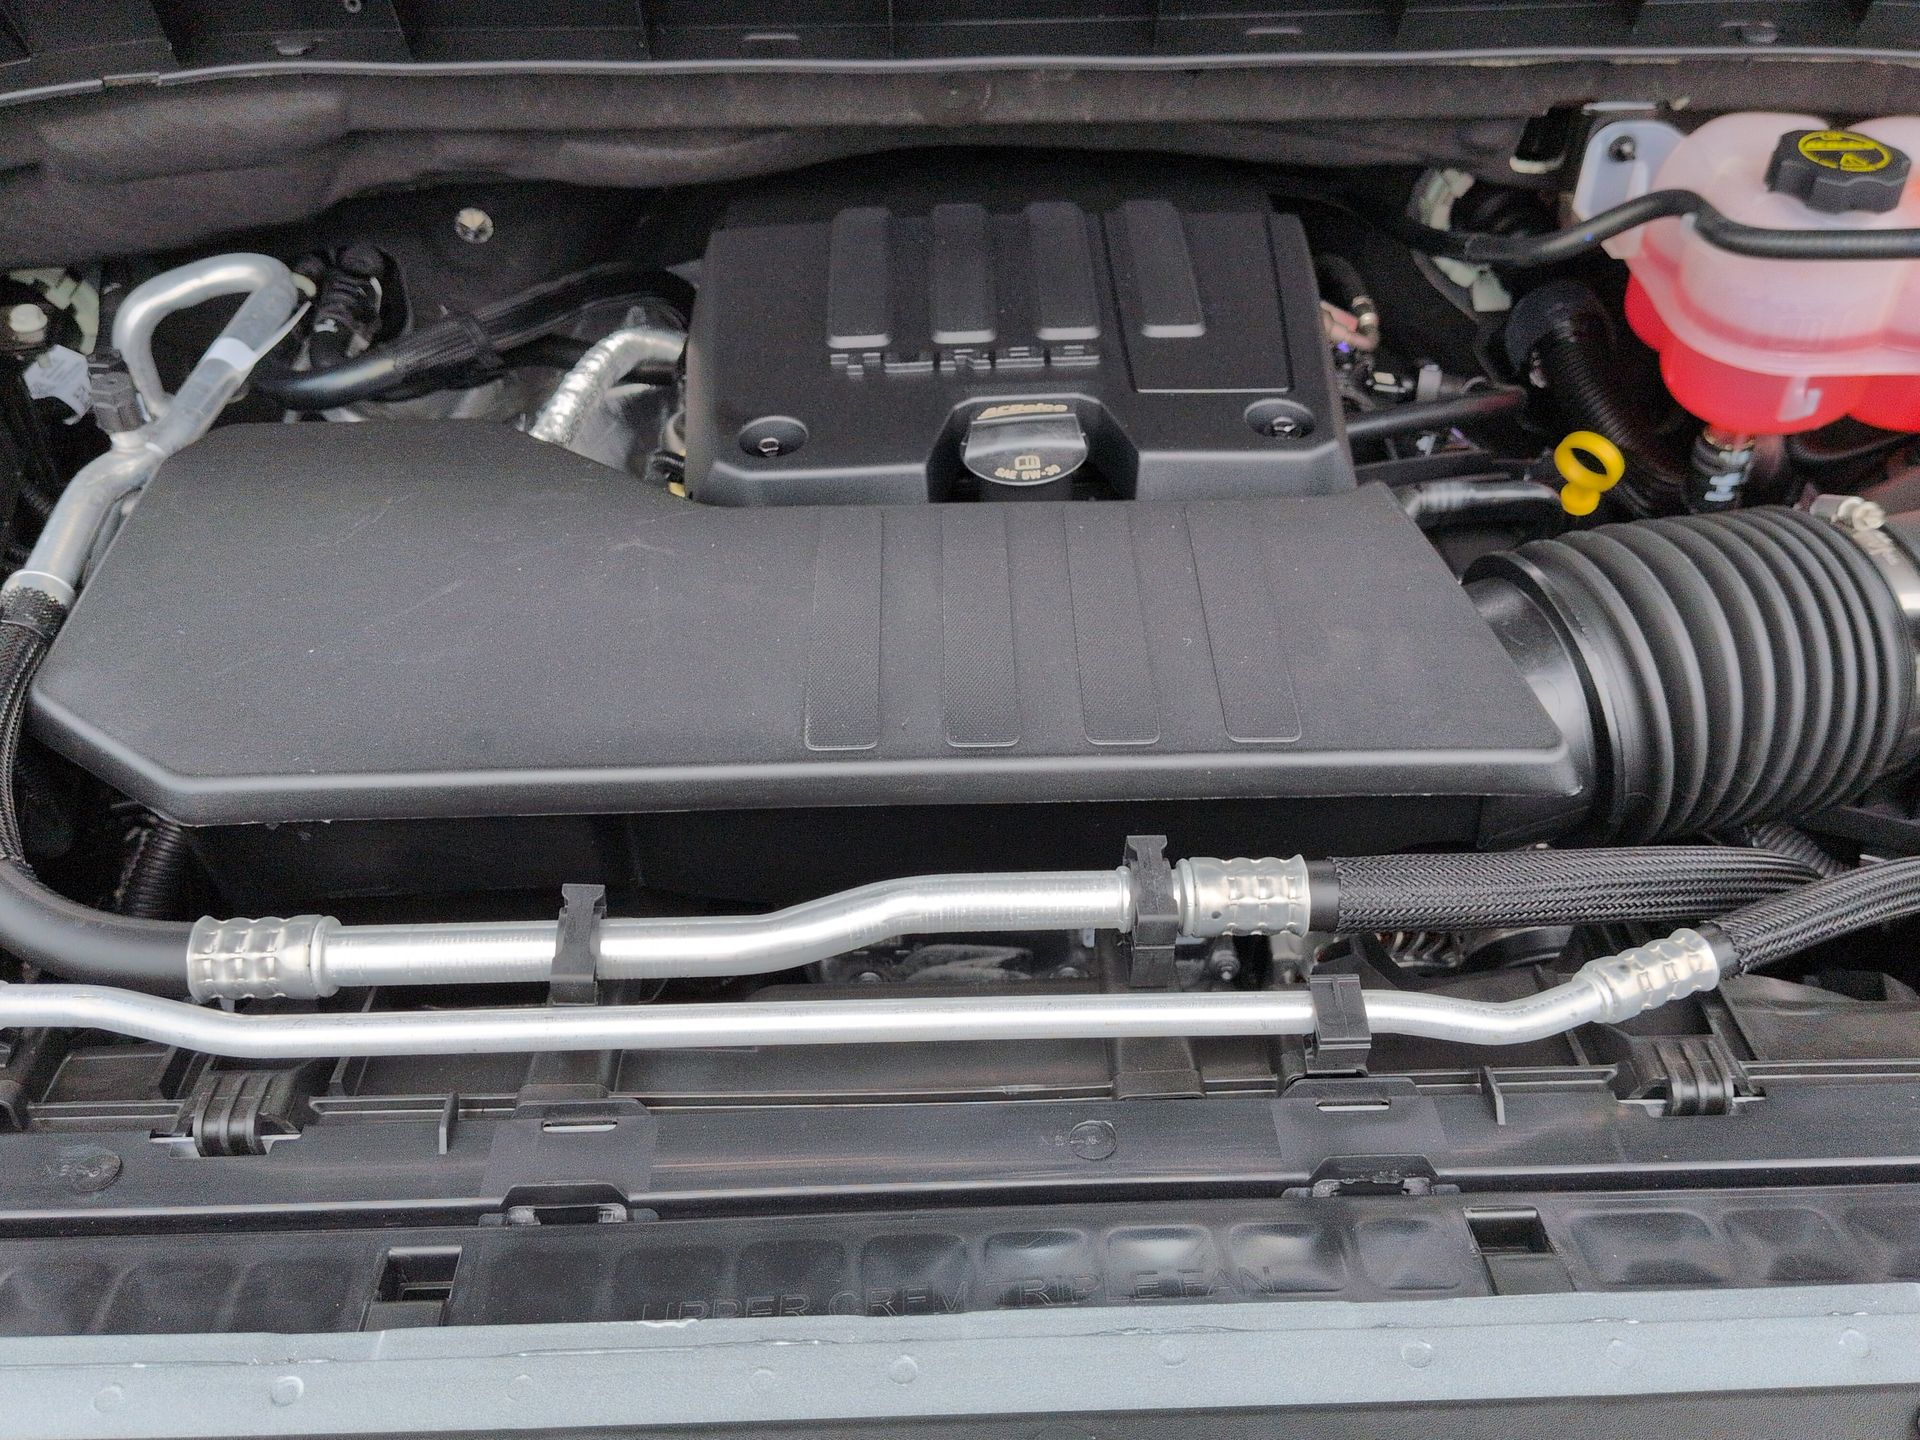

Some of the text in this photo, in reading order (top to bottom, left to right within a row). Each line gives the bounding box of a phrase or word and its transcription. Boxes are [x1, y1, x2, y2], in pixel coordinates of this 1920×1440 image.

[977, 402, 1068, 420] ACDelco
[994, 467, 1018, 479] SAE
[985, 1271, 1163, 1306] TRIPLE
[1176, 1265, 1277, 1300] FAN
